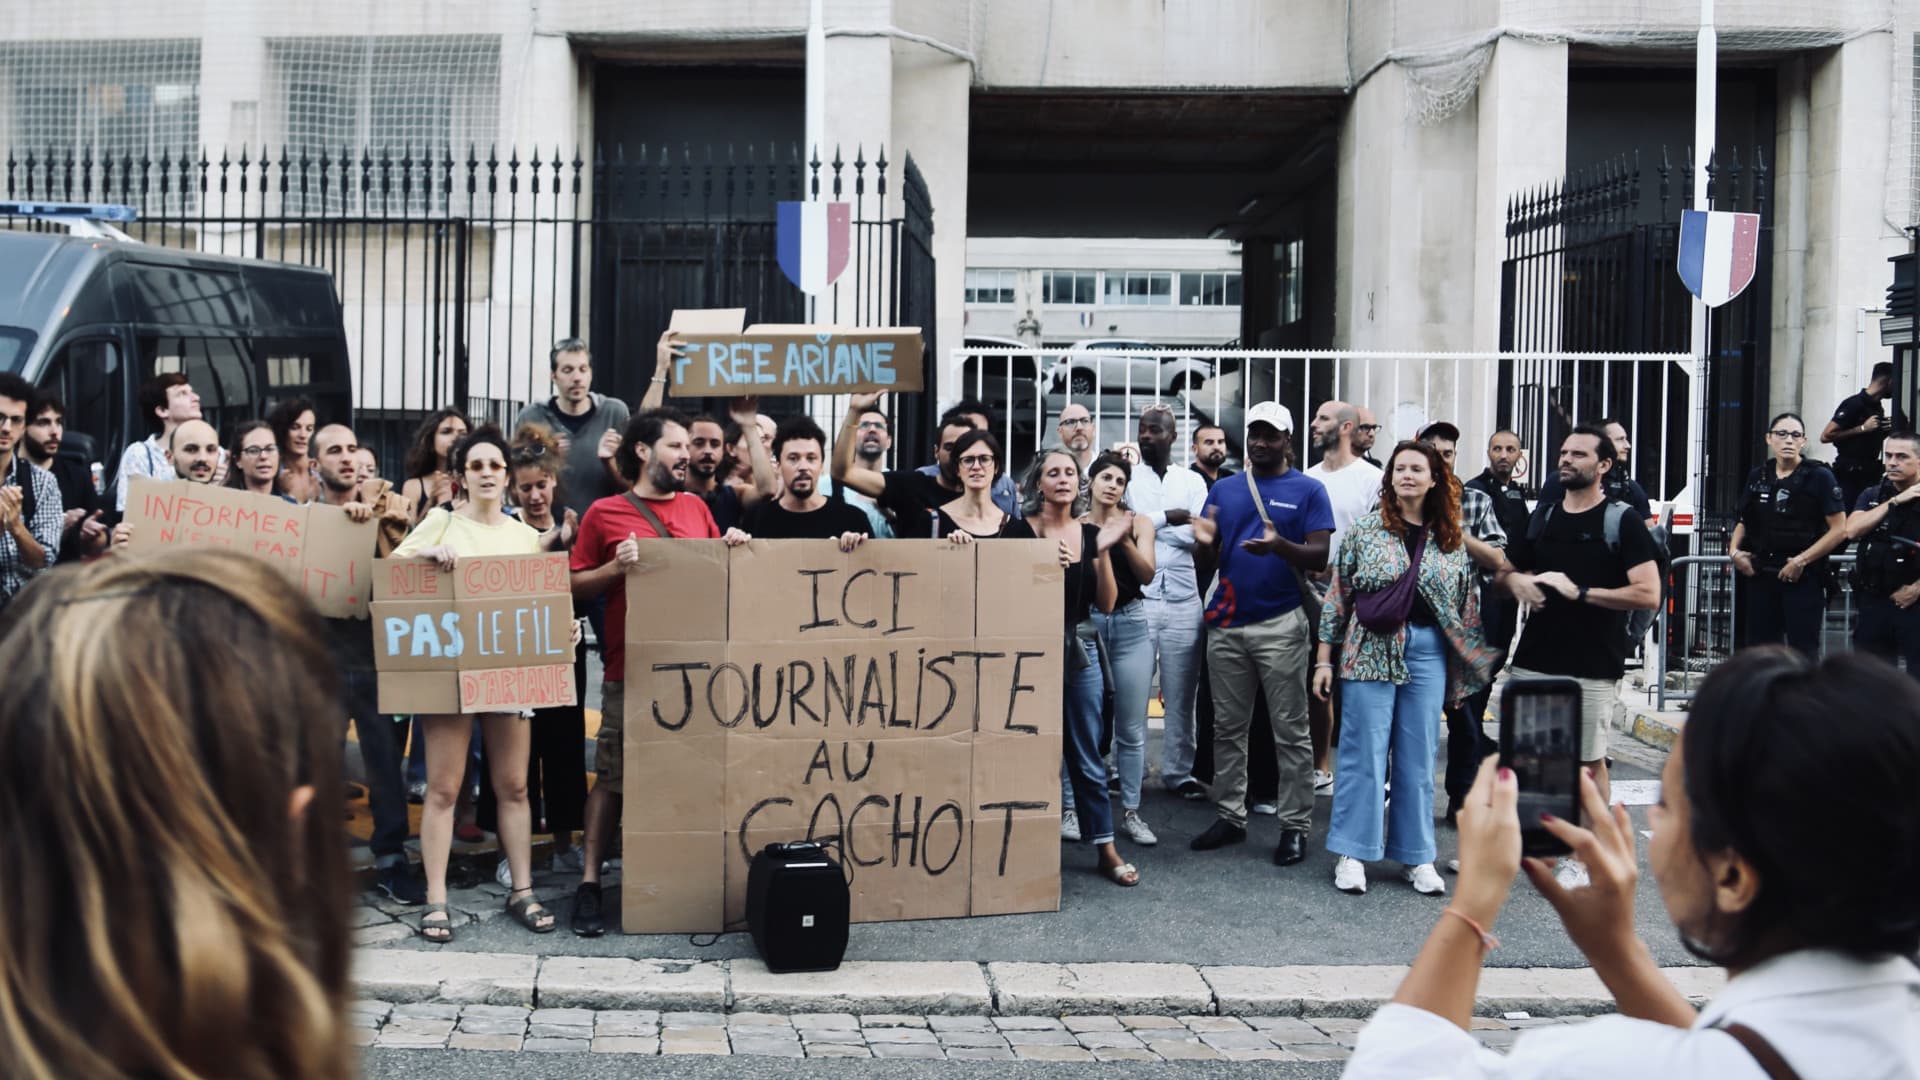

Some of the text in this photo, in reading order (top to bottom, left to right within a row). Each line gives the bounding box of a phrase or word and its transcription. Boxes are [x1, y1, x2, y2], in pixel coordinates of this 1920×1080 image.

[675, 342, 777, 387] FREE
[144, 494, 300, 537] INFORMER
[254, 539, 300, 559] PAS
[390, 556, 571, 596] NE COUPEZ
[797, 568, 918, 635] ICI
[384, 610, 465, 659] PAS
[477, 610, 505, 656] LE
[801, 739, 875, 785] AU
[738, 791, 1050, 877] CACHOT
